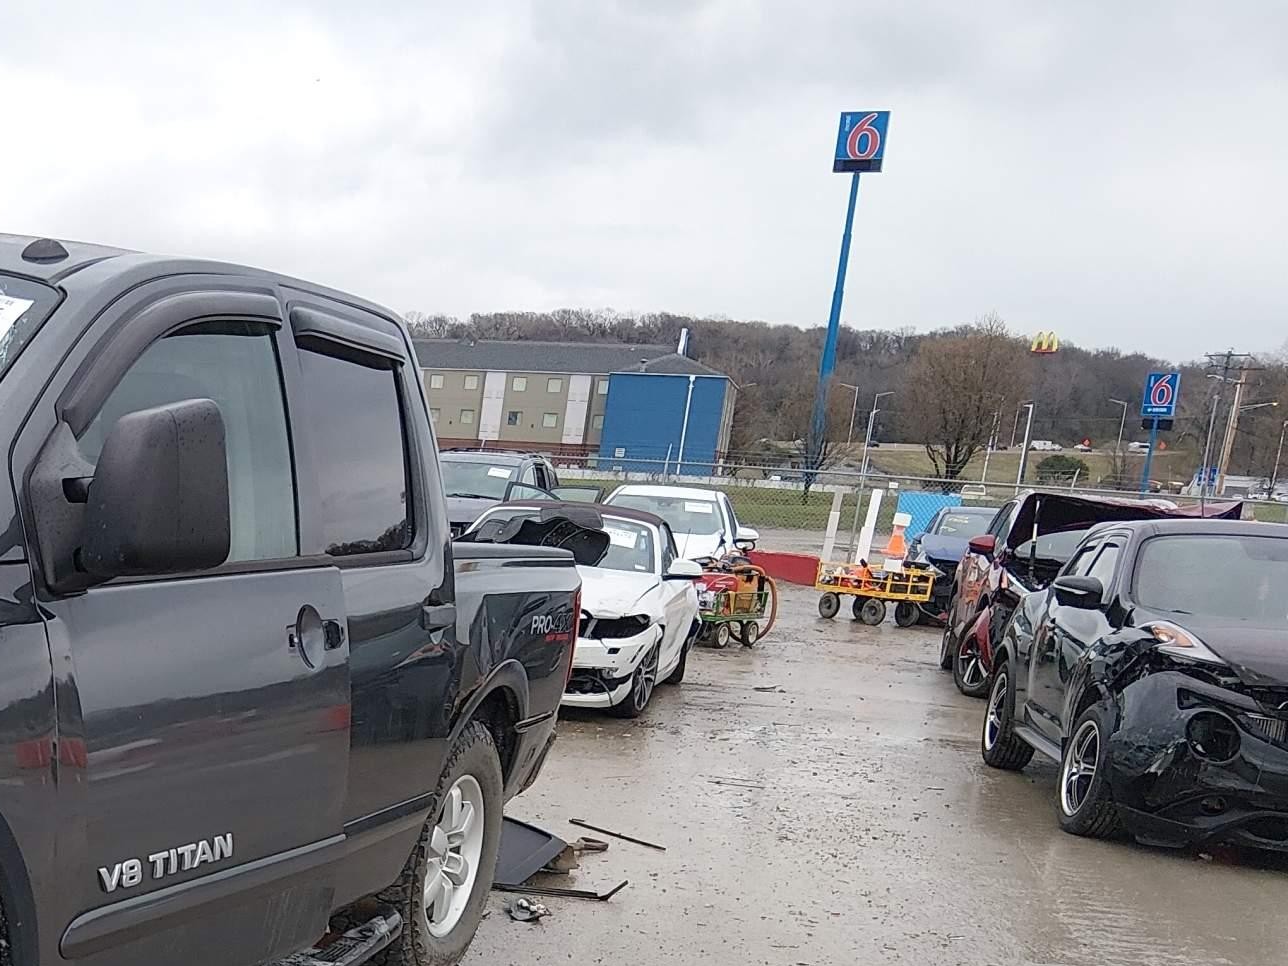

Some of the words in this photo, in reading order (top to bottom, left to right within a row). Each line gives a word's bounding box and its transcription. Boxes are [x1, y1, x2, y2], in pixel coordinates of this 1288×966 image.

[846, 112, 881, 160] 6
[1150, 374, 1173, 407] 6
[98, 858, 142, 893] V8
[148, 833, 233, 879] TITAN
